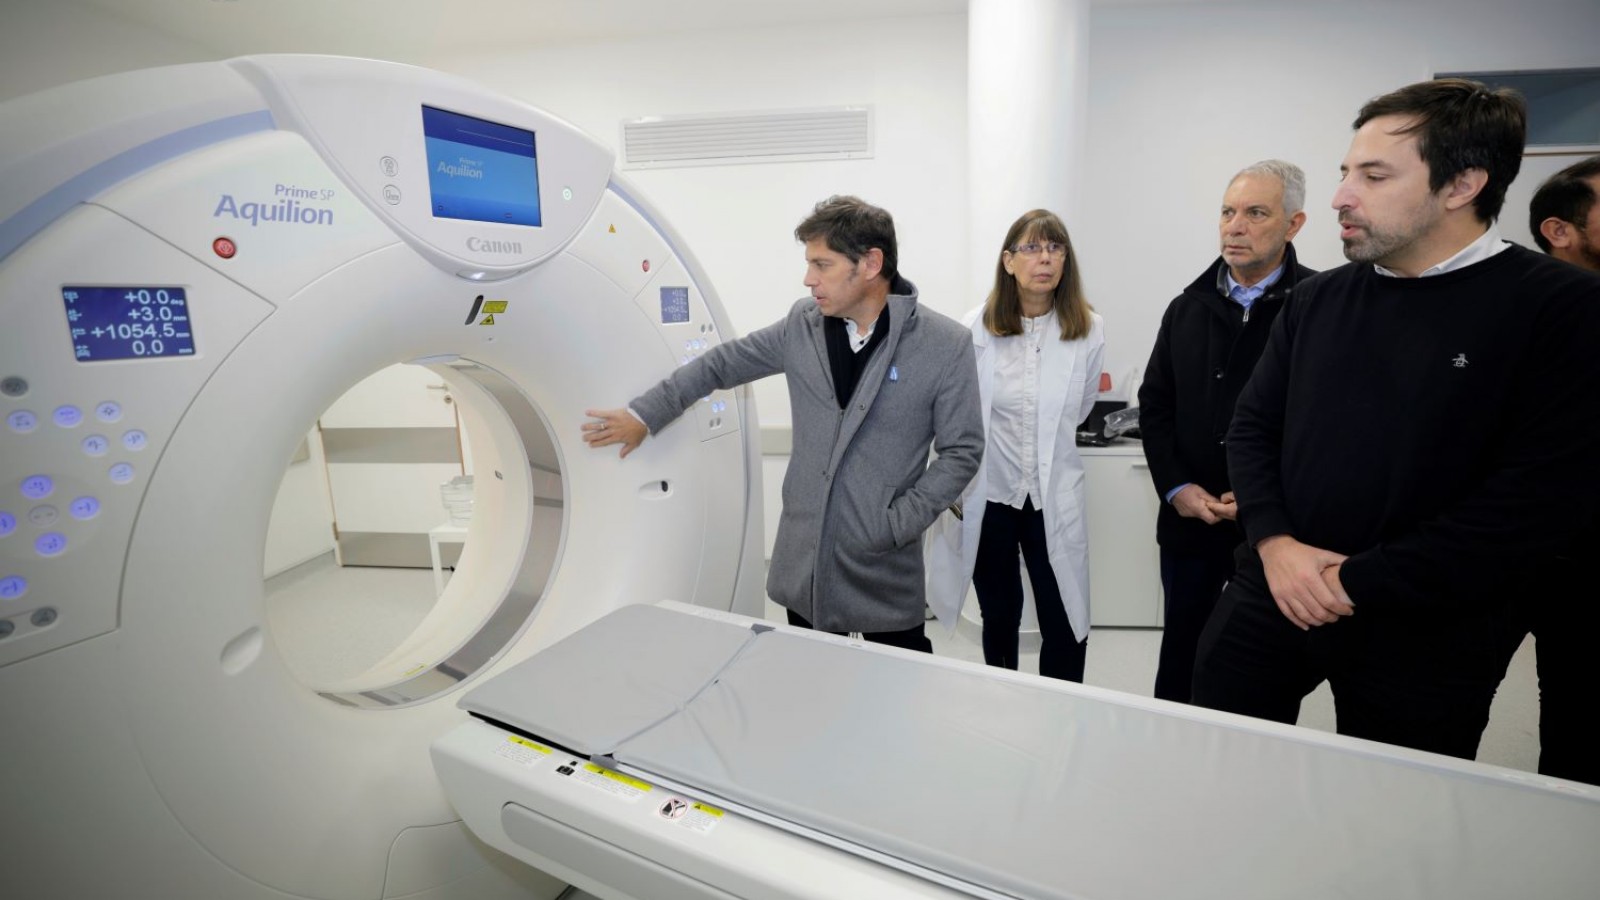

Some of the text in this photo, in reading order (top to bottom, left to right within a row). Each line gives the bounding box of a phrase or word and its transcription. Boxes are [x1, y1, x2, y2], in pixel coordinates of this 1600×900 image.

[436, 160, 483, 179] Aquilion
[274, 184, 335, 201] Prime SP
[213, 194, 334, 227] Aquilion
[466, 236, 523, 254] Canon
[124, 290, 169, 305] +0.0
[128, 306, 172, 322] +3.0
[91, 323, 175, 340] +1054.5
[132, 340, 164, 355] 0.0
